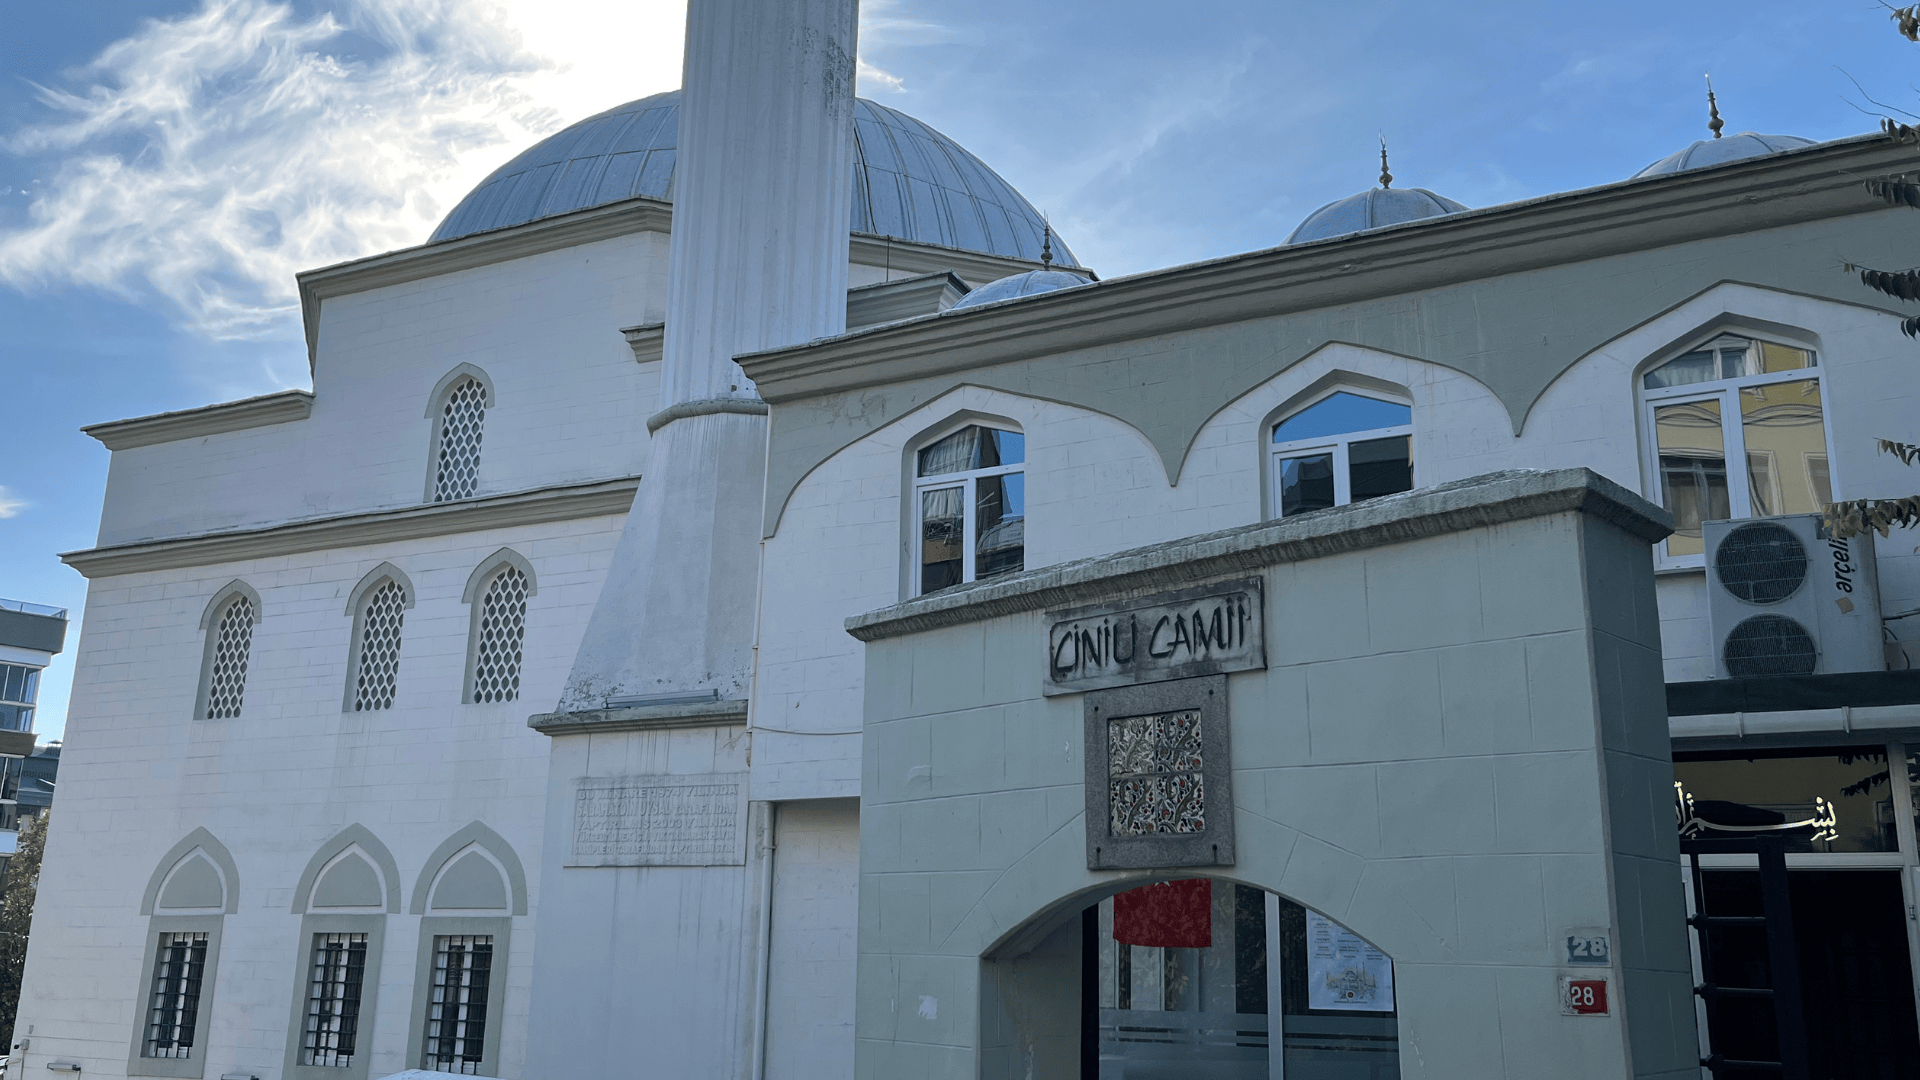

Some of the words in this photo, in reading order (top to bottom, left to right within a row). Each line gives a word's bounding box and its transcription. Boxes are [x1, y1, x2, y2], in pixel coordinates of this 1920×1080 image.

[1827, 536, 1854, 593] arçeli
[578, 789, 596, 801] BU
[597, 788, 648, 800] MİNARE
[651, 786, 682, 799] 1974
[686, 784, 738, 797] YILINDA
[640, 801, 671, 816] UYSAL
[673, 803, 737, 816] TARAFINDAN
[652, 818, 683, 829] 2003
[686, 817, 736, 829] YILINDA
[616, 845, 667, 855] TARAFINDAN
[1572, 936, 1606, 957] 28
[1571, 986, 1595, 1006] 28
